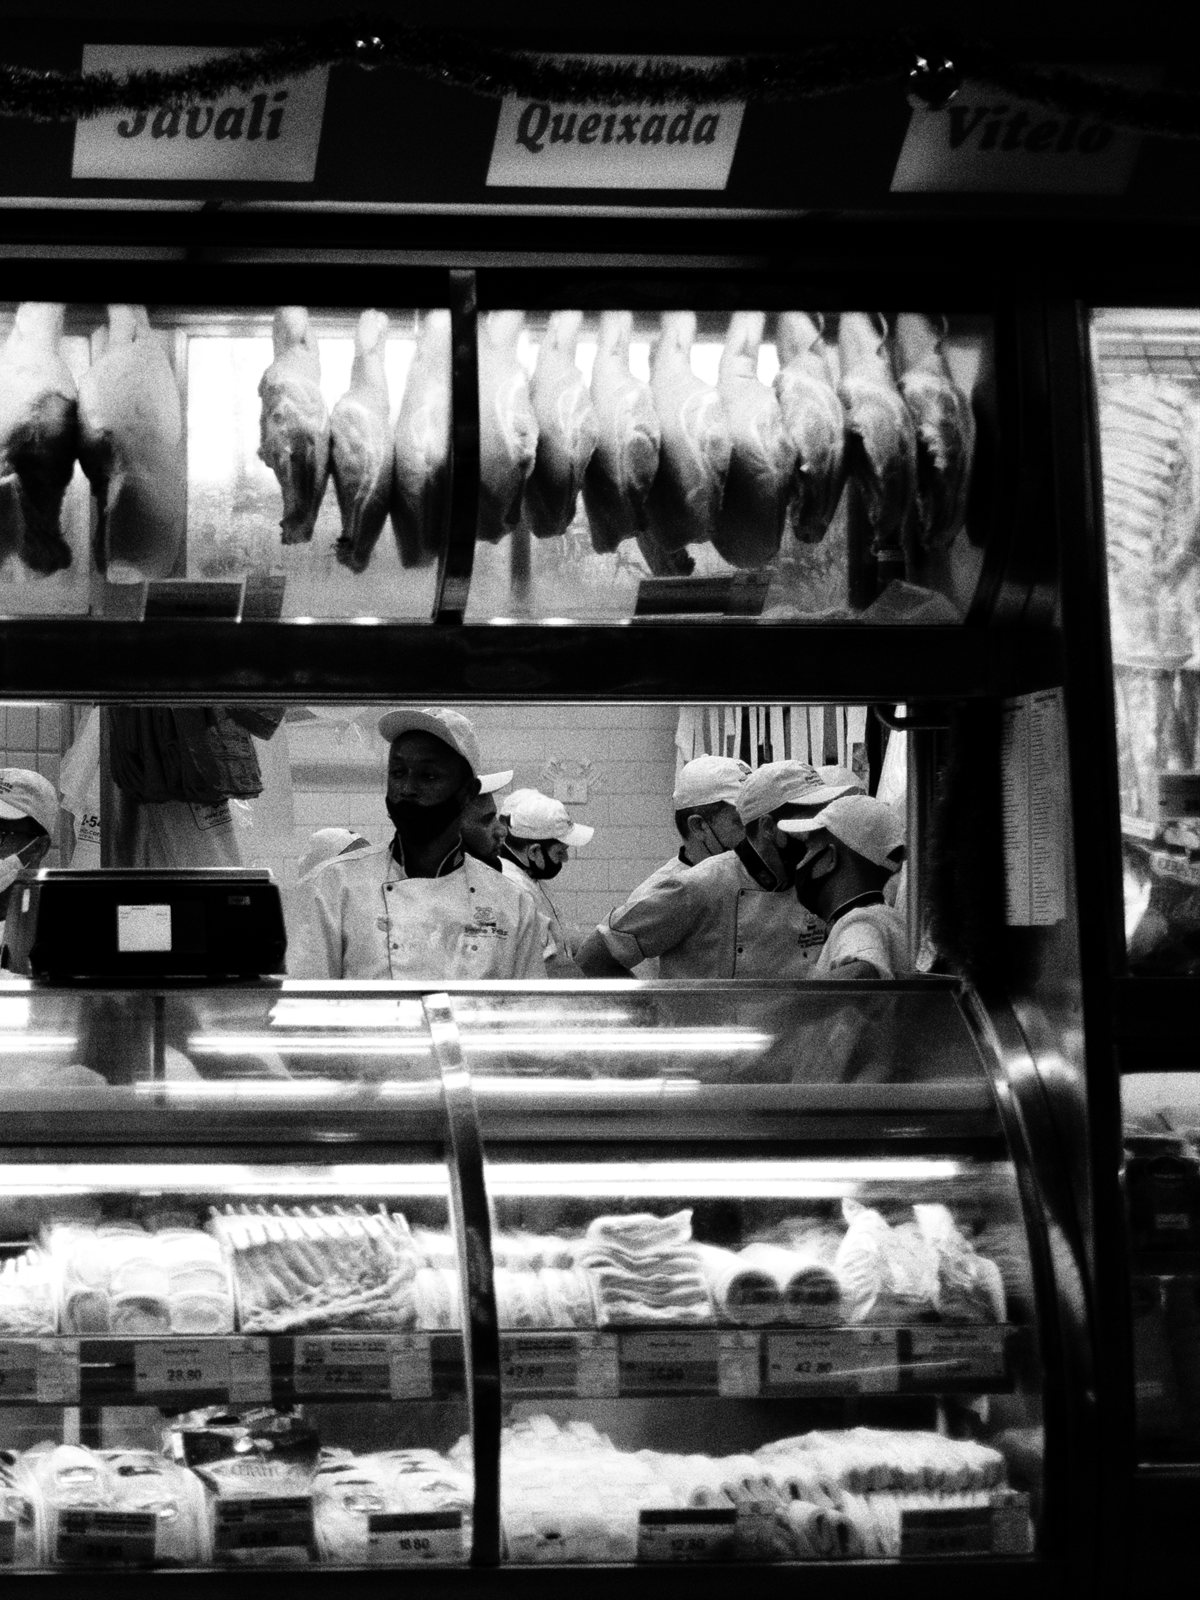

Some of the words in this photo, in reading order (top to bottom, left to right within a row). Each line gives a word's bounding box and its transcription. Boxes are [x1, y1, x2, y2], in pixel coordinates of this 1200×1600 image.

[117, 91, 288, 141] Javali
[515, 102, 721, 154] Queixada
[948, 104, 1115, 154] Vitelo
